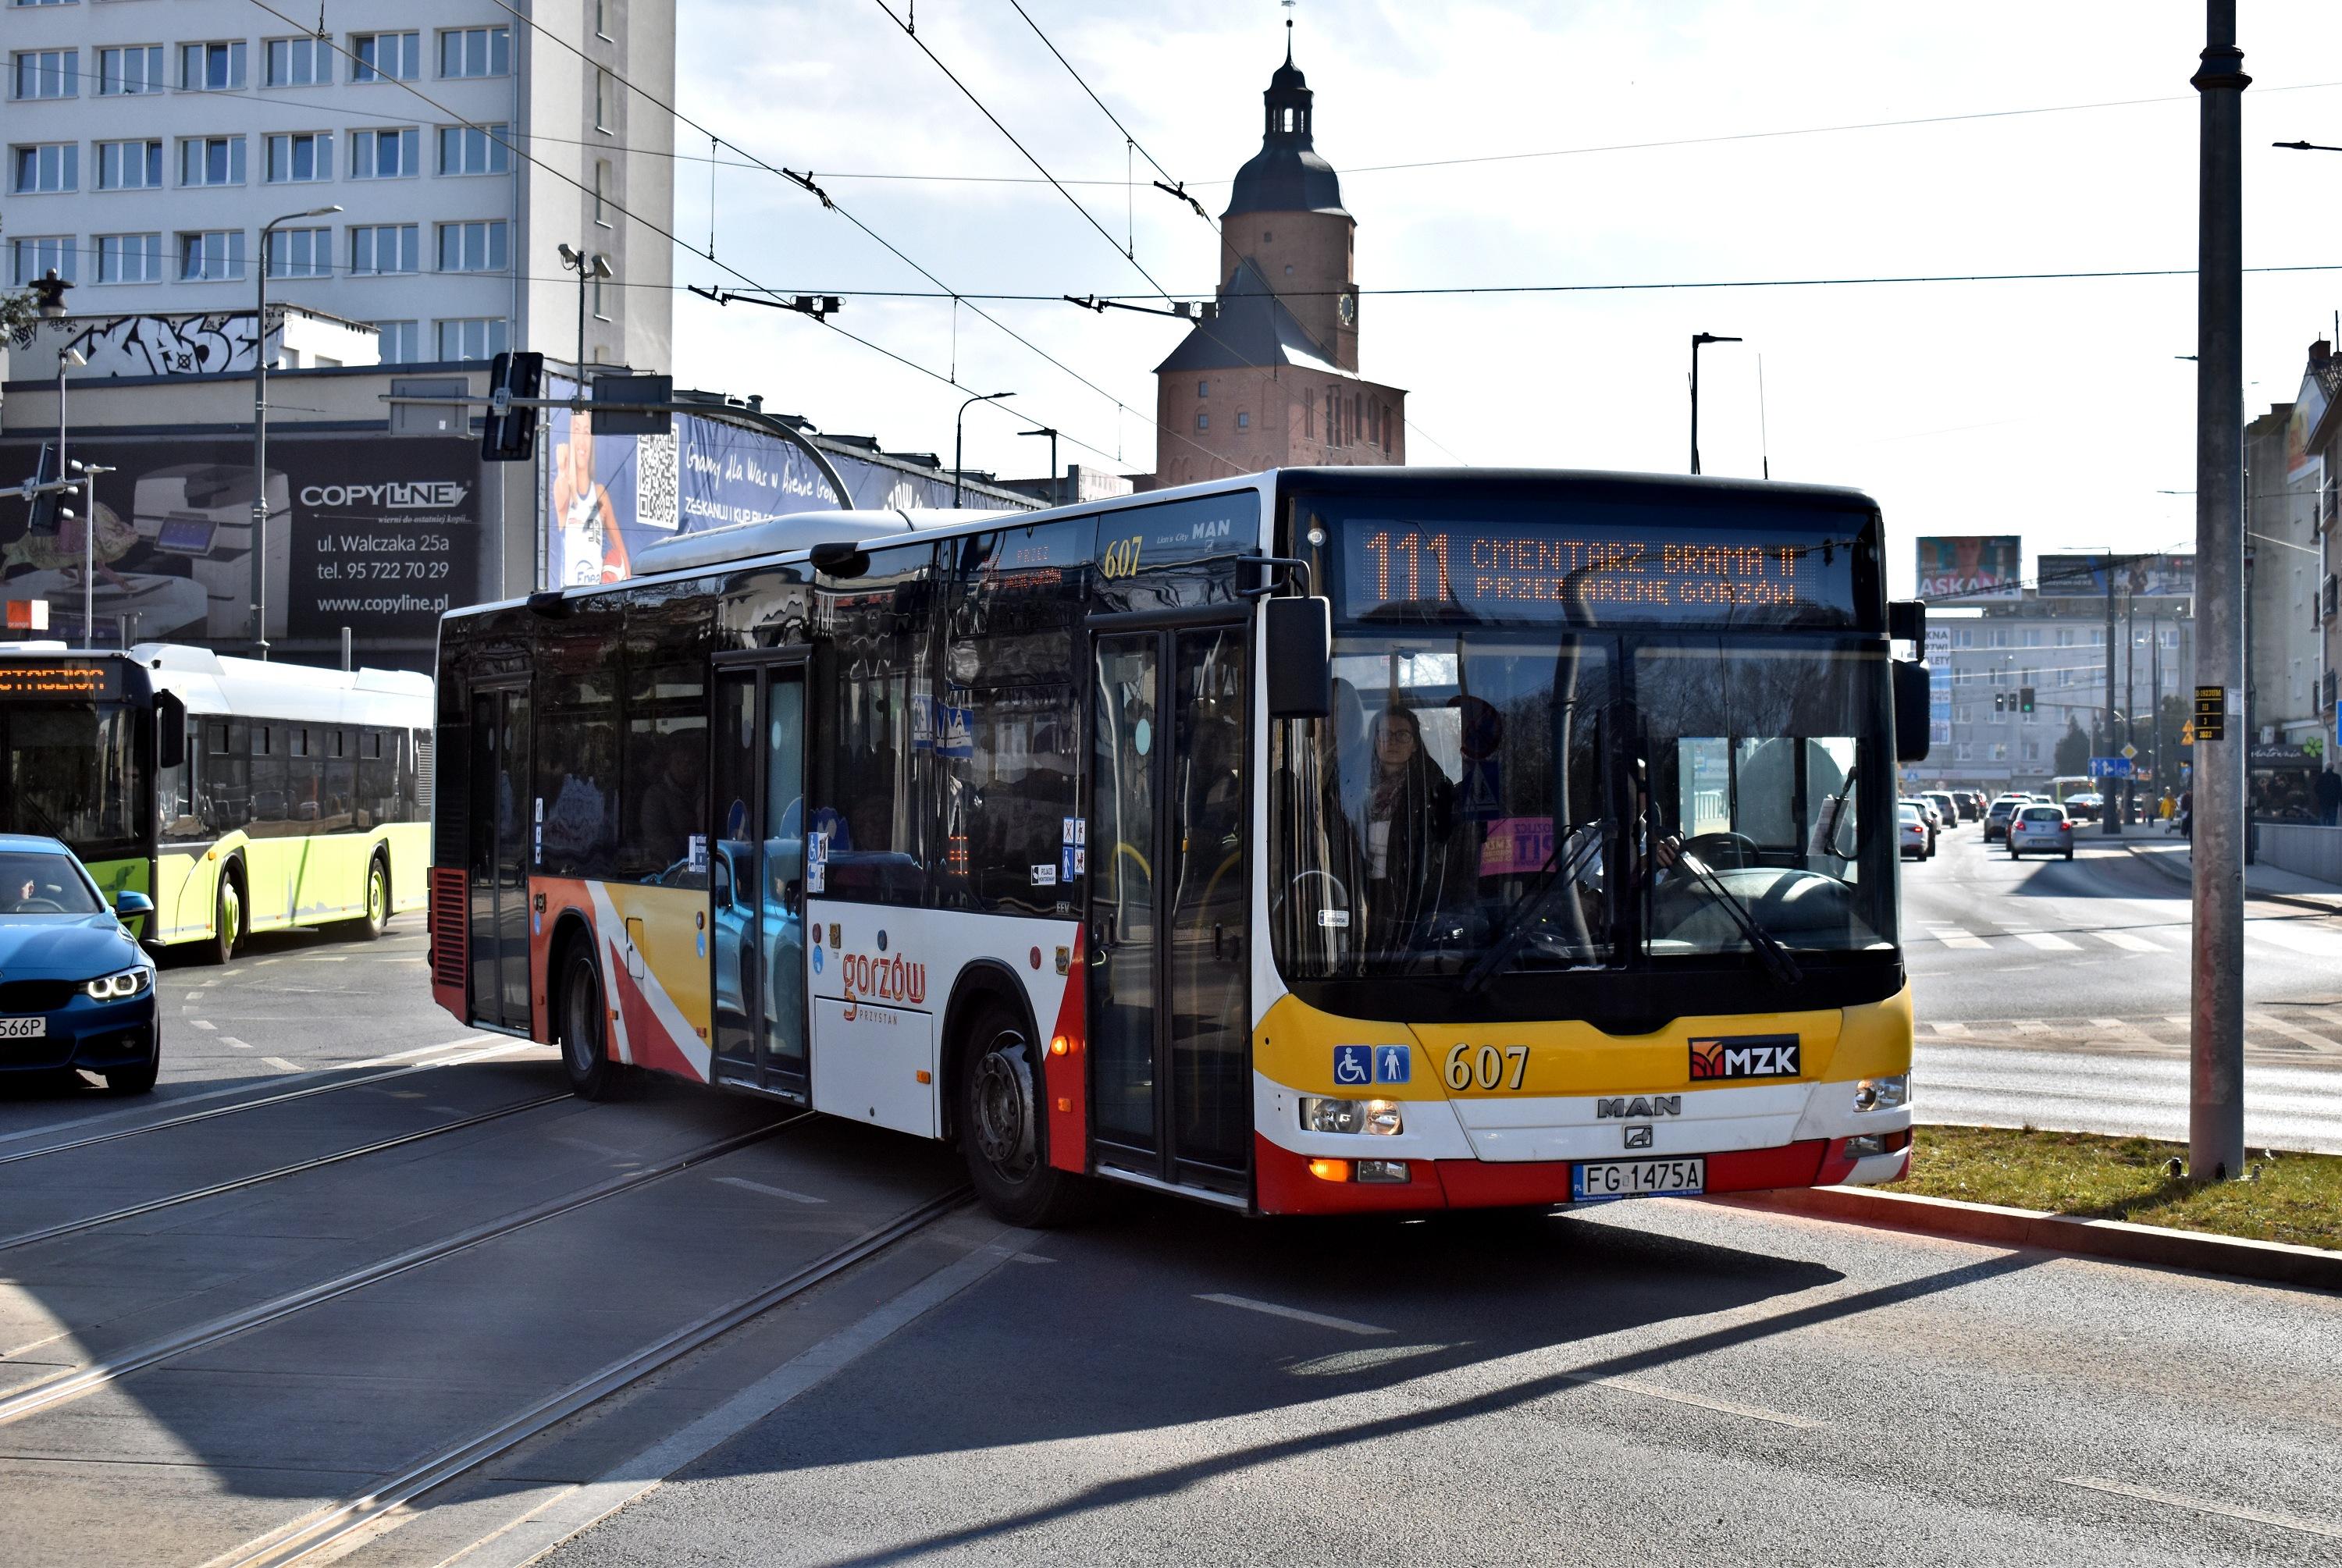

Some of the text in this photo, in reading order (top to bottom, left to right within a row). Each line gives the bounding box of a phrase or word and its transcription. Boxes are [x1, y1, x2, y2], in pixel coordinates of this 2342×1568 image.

[686, 440, 721, 491] Gramy
[725, 454, 742, 482] dla
[748, 457, 767, 487] Was
[782, 459, 813, 497] Arenie
[300, 482, 457, 507] COPYLINE
[685, 496, 728, 519] ZESKANUJ
[1175, 534, 1189, 542] City
[1192, 519, 1230, 540] MAN
[318, 535, 450, 552] ul. Walczaka 25a
[1105, 535, 1143, 580] 607
[1366, 532, 1447, 601] 111
[1472, 539, 1644, 572] CMENTARZ
[1664, 544, 1763, 575] BRAMA
[318, 562, 450, 579] tel. 95 722 70 29
[1475, 577, 1794, 606] PRZEZ ARENĘ GORZÓW
[1918, 578, 2018, 596] ASKANA
[317, 594, 449, 614] www.copyline.pl
[1925, 631, 1948, 640] KNA
[1057, 901, 1070, 914] EEV
[842, 952, 926, 1022] gorzów
[0, 1019, 41, 1036] 566P
[860, 1009, 898, 1026] PRZYSTAŃ
[1444, 1043, 1529, 1091] 607
[1724, 1046, 1797, 1076] MZK
[1596, 1096, 1682, 1118] MAN
[1575, 1161, 1699, 1193] PL FG 1475A
